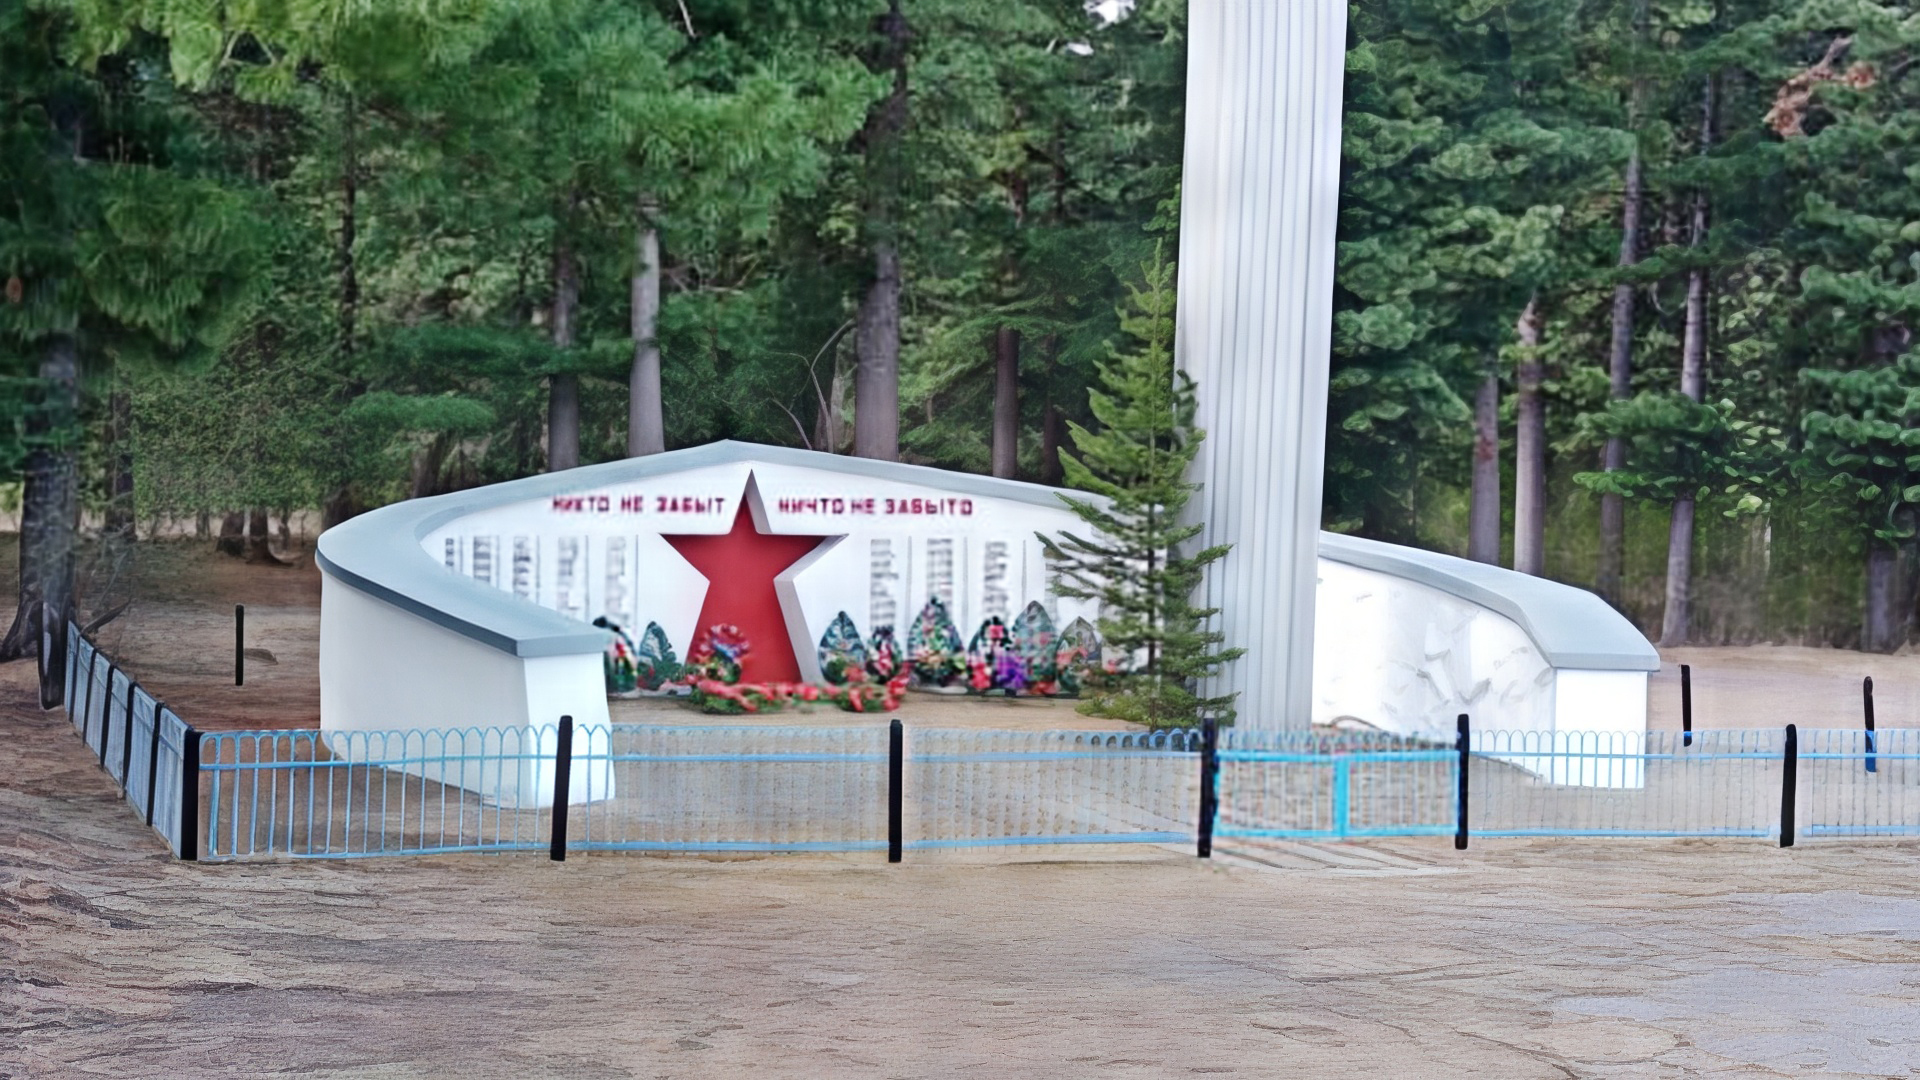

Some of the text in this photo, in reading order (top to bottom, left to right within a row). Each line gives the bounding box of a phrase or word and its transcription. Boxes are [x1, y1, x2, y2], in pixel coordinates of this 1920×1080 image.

[621, 496, 643, 512] НЕ
[657, 497, 724, 513] ЗАБЫТ
[851, 499, 875, 514] НЕ
[885, 499, 973, 515] ЗАБЫТО
